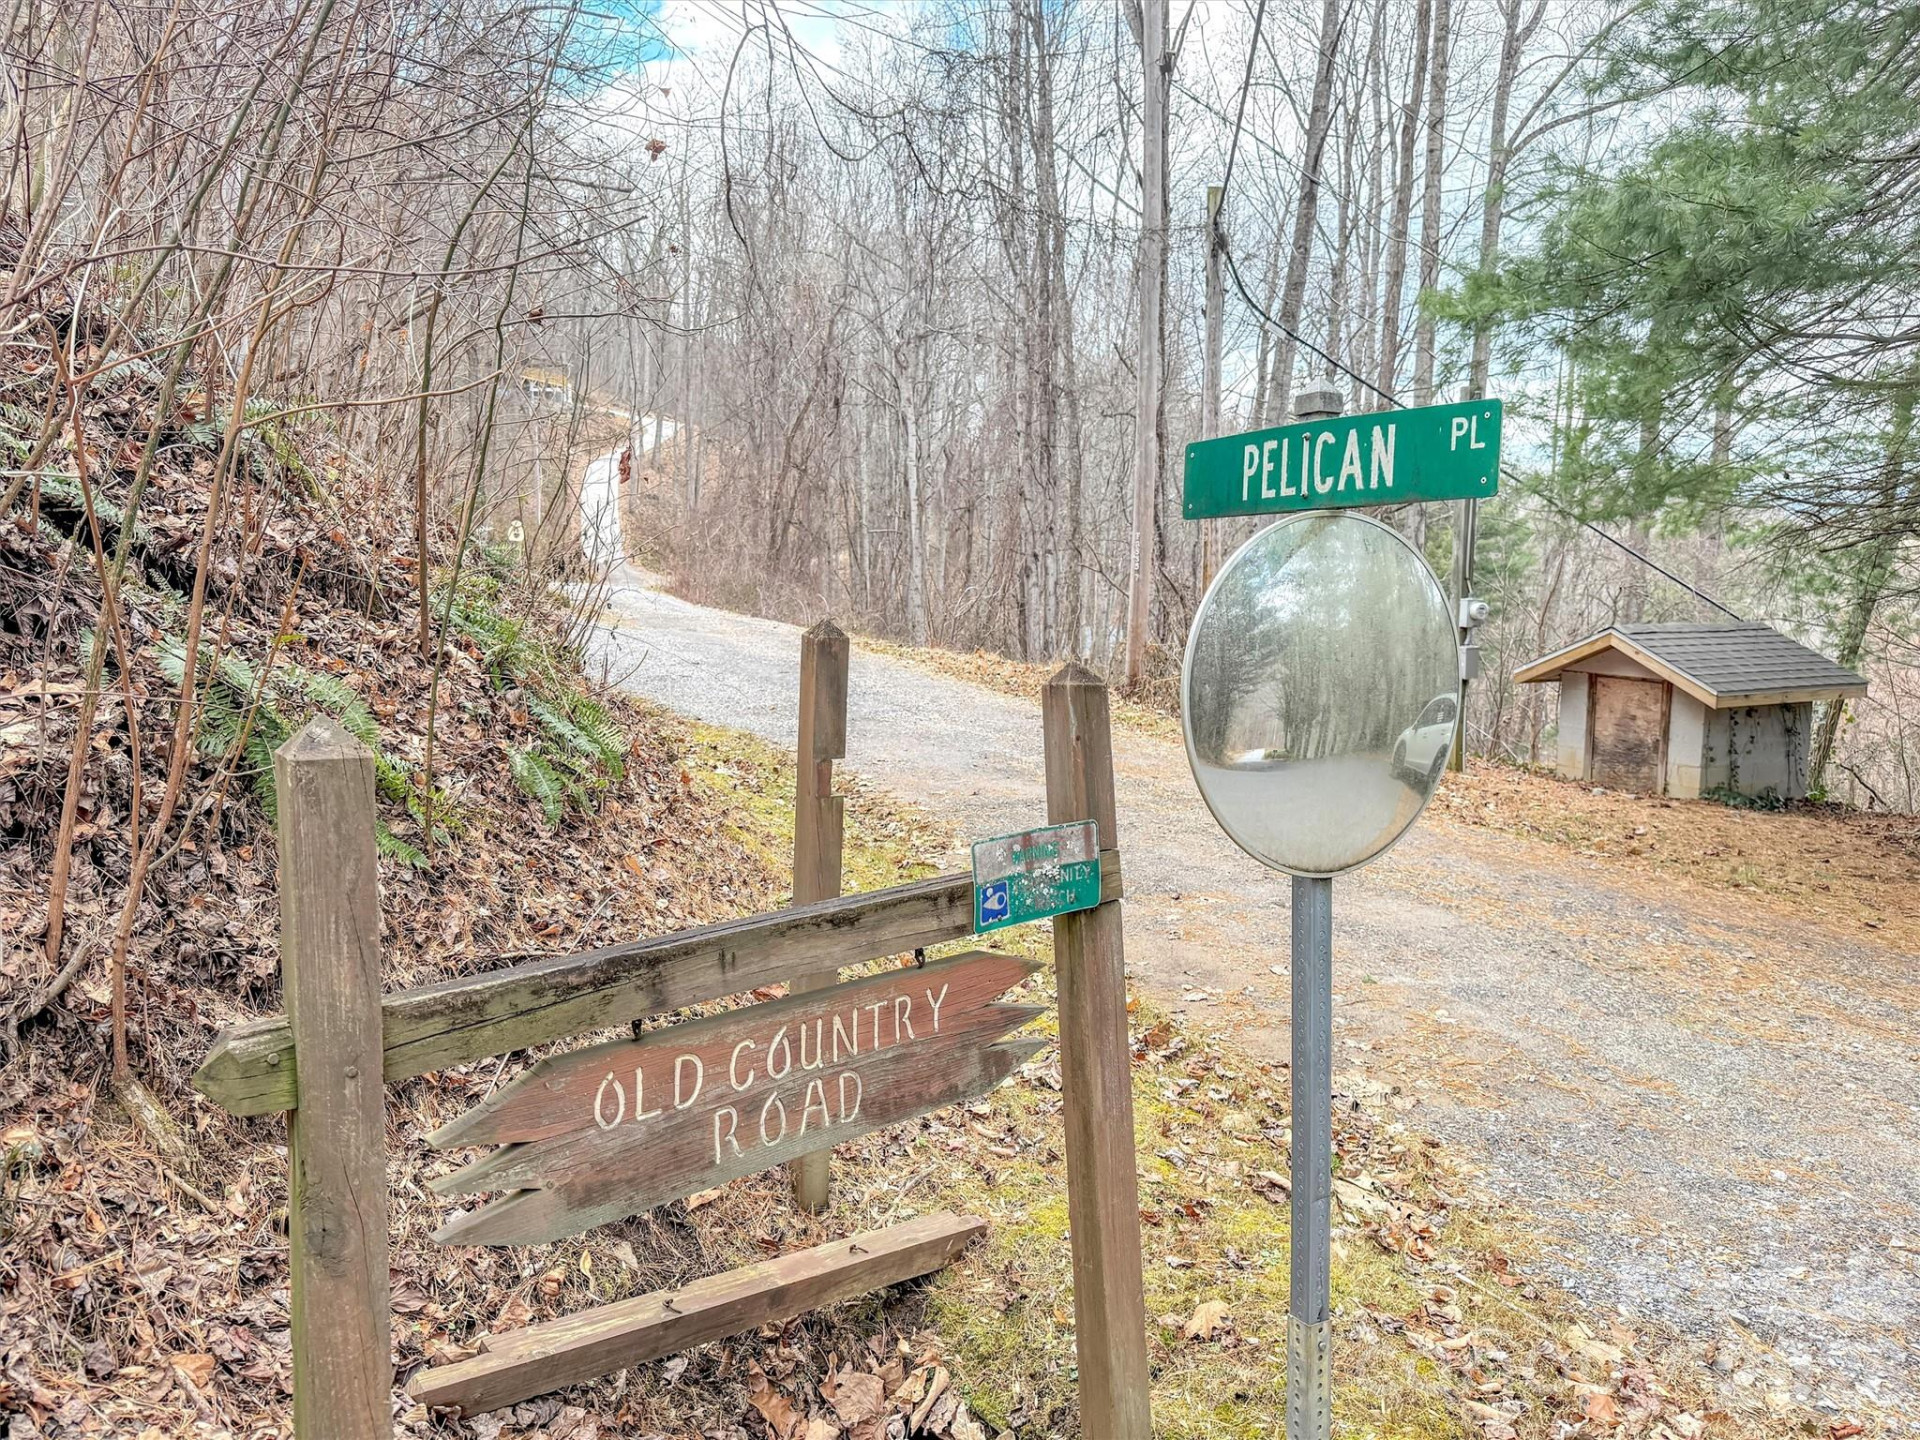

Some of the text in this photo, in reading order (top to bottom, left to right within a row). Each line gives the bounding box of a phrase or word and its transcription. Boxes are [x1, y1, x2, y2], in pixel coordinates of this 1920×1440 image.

[1242, 415, 1486, 501] PELICAN PL
[594, 983, 949, 1131] OLD COUNTRY
[713, 1069, 862, 1165] ROAD
